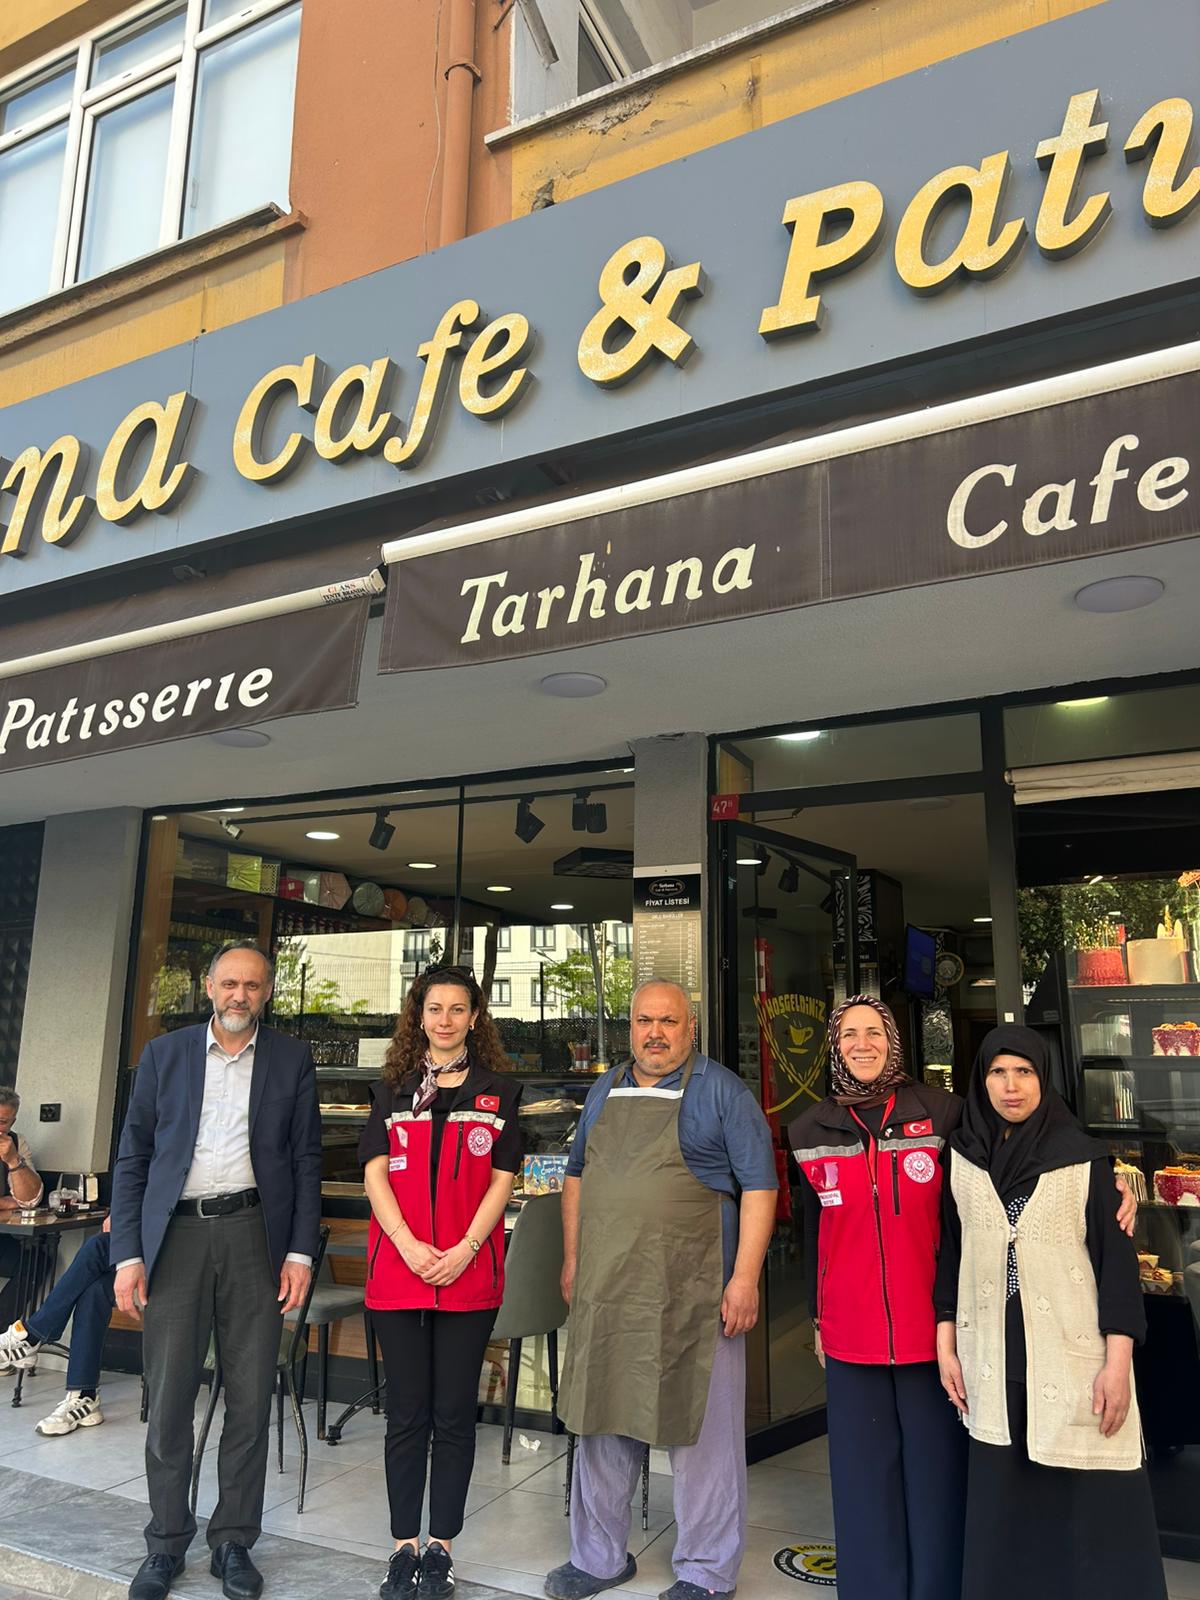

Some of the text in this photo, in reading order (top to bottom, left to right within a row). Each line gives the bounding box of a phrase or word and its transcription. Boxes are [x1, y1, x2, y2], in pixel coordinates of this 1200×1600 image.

[232, 299, 531, 483] Cafe
[577, 235, 702, 382] &
[459, 434, 1190, 643] Tarhana Cafe
[645, 897, 690, 907] FİYAT LİSTESİ
